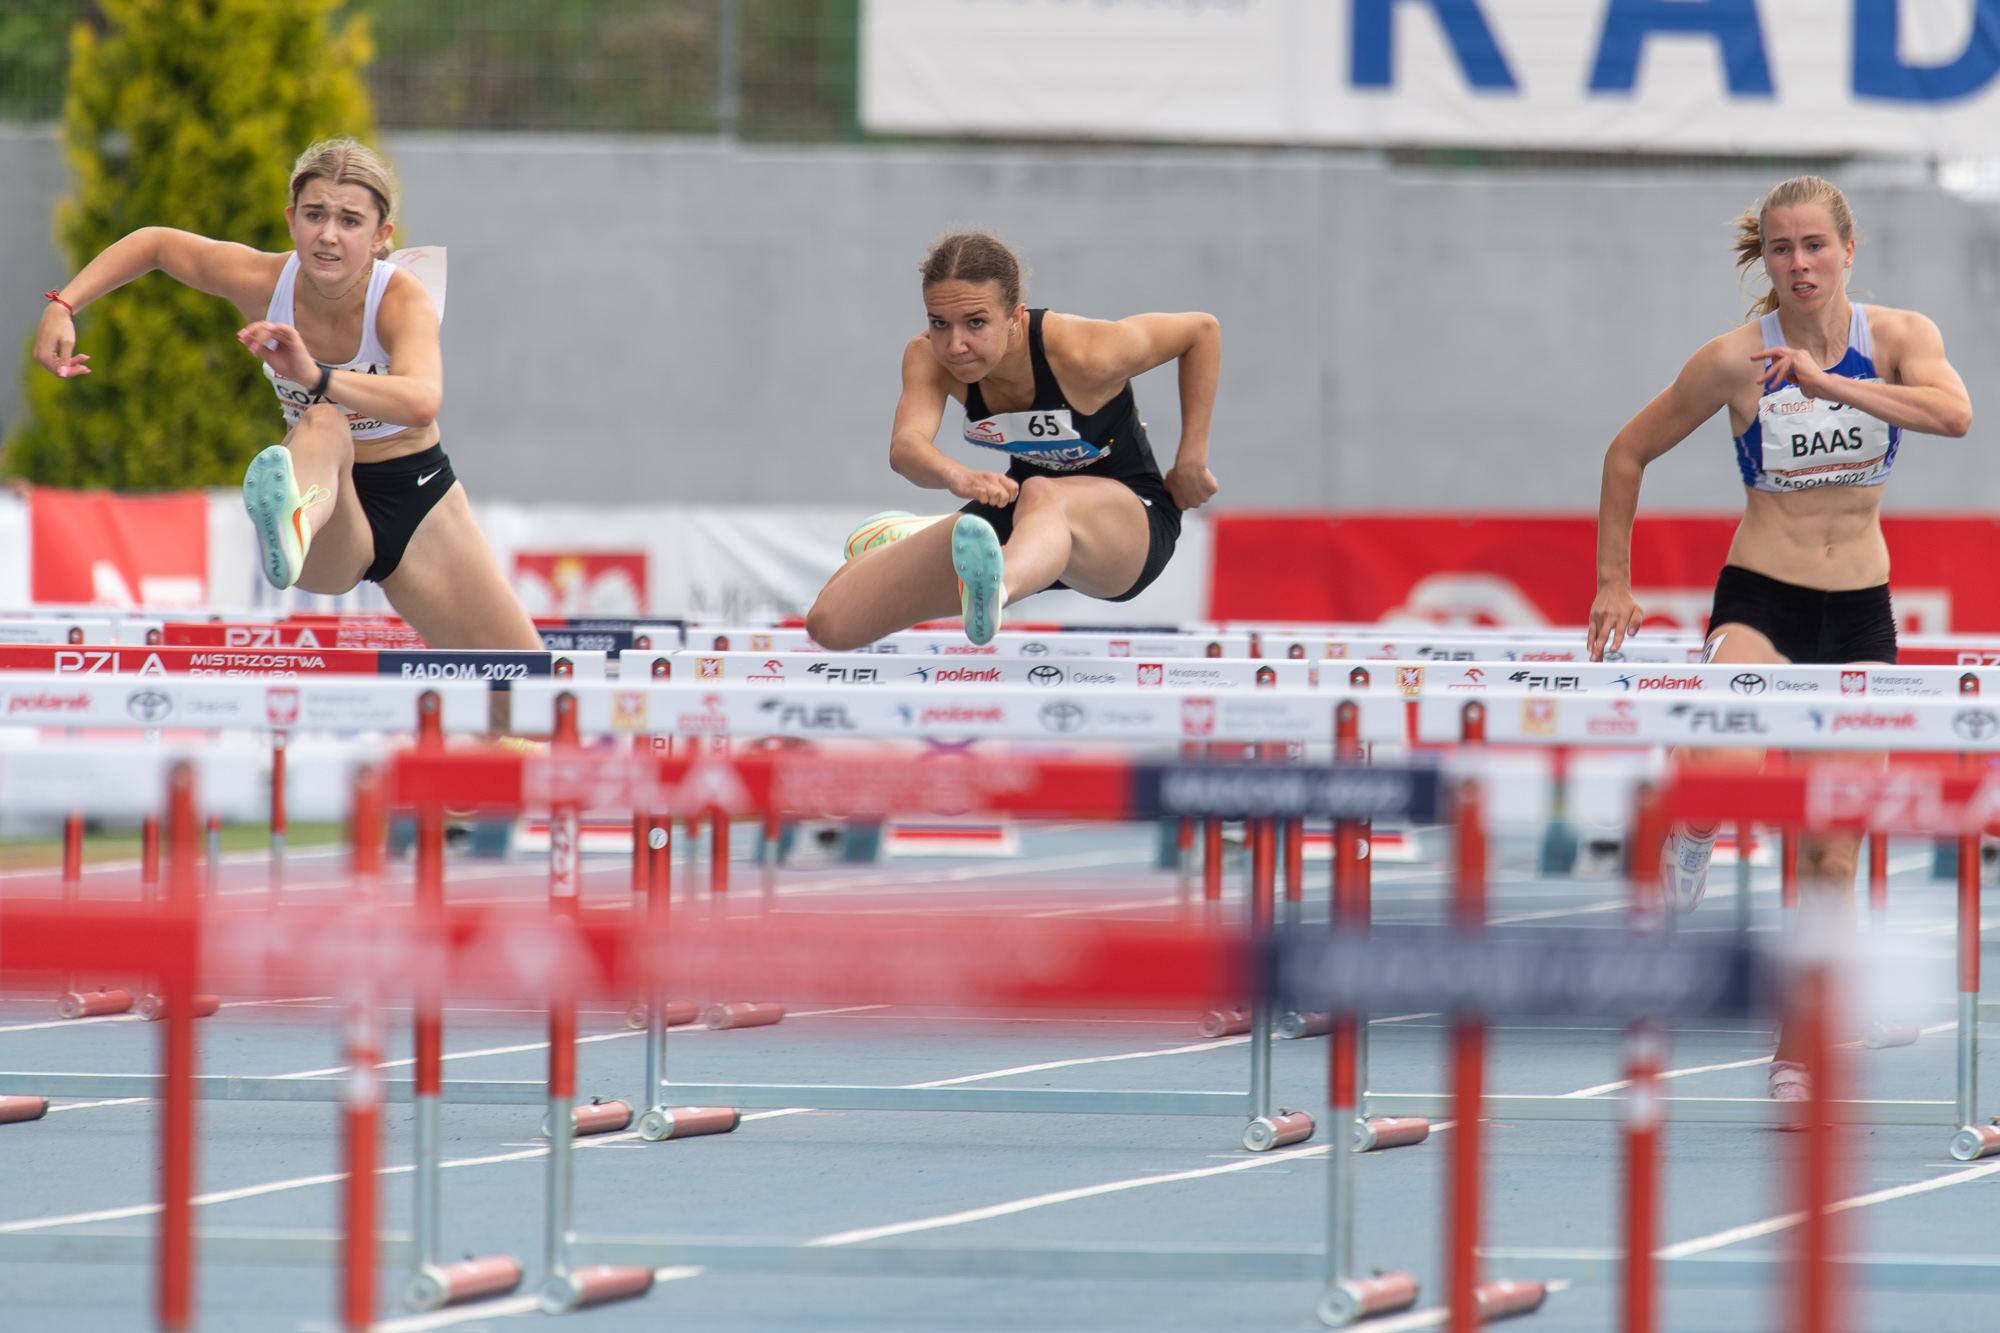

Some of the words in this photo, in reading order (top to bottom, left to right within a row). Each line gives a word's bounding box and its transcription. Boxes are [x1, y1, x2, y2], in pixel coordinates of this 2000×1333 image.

[349, 420, 384, 431] 2022
[1028, 414, 1060, 437] 65
[1791, 426, 1864, 458] BAAS
[225, 627, 321, 648] PZLA
[54, 651, 168, 677] PZLA
[190, 653, 326, 668] MISTRZOSTWA
[401, 662, 475, 680] RADOM
[481, 664, 529, 681] 2022
[826, 668, 887, 685] FUEL
[935, 667, 1001, 684] polanik
[1528, 676, 1589, 693] FUEL
[1637, 674, 1704, 692] polanik
